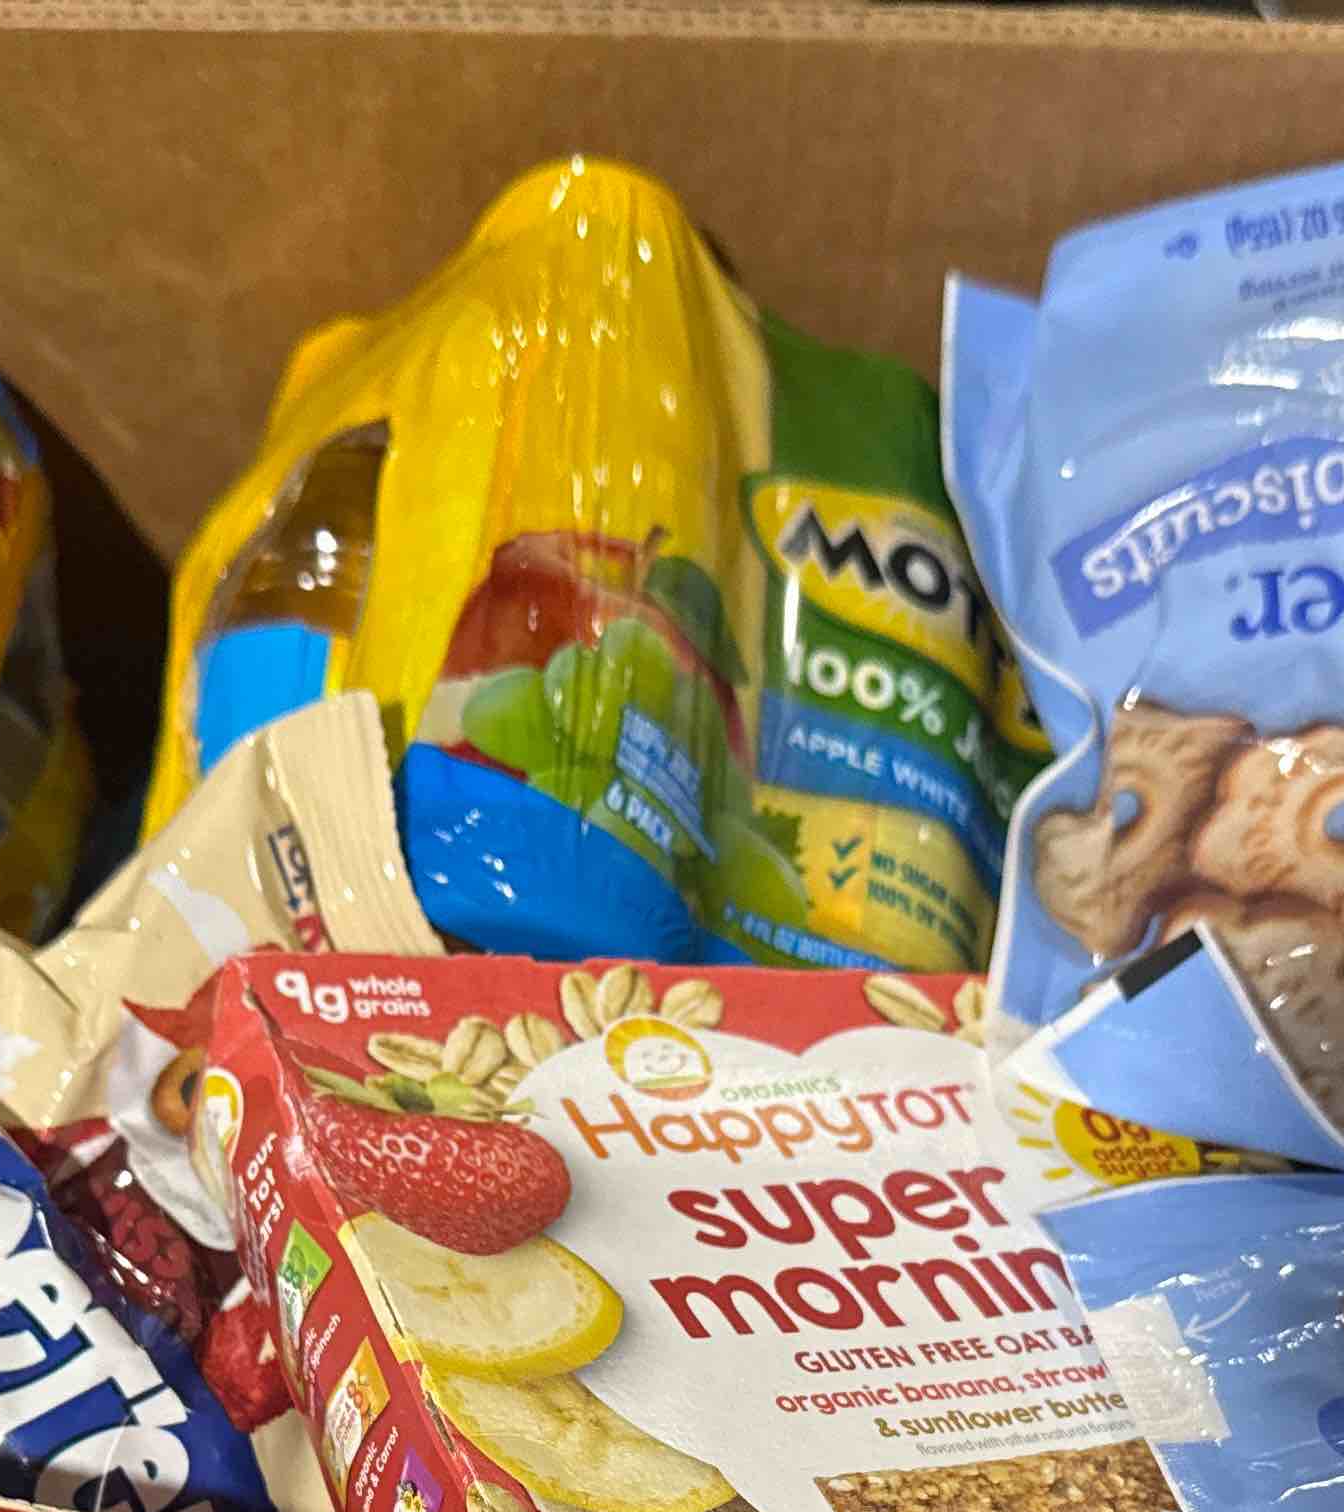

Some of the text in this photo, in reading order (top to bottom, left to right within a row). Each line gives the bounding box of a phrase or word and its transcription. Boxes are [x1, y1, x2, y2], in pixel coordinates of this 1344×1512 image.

[786, 725, 883, 779] APPLE
[274, 969, 348, 1022] 9g
[348, 976, 423, 999] whole
[353, 996, 432, 1021] grains
[719, 1077, 842, 1102] ORGANICS
[1092, 1141, 1178, 1163] added
[667, 1165, 1009, 1261] super
[650, 1235, 1072, 1340] mornin
[311, 1313, 341, 1369] Spinach
[794, 1324, 1095, 1376] GLUTEN FREE OAT BA
[775, 1358, 1110, 1416] organic banana, straw
[873, 1390, 1128, 1439] & sunflower butte
